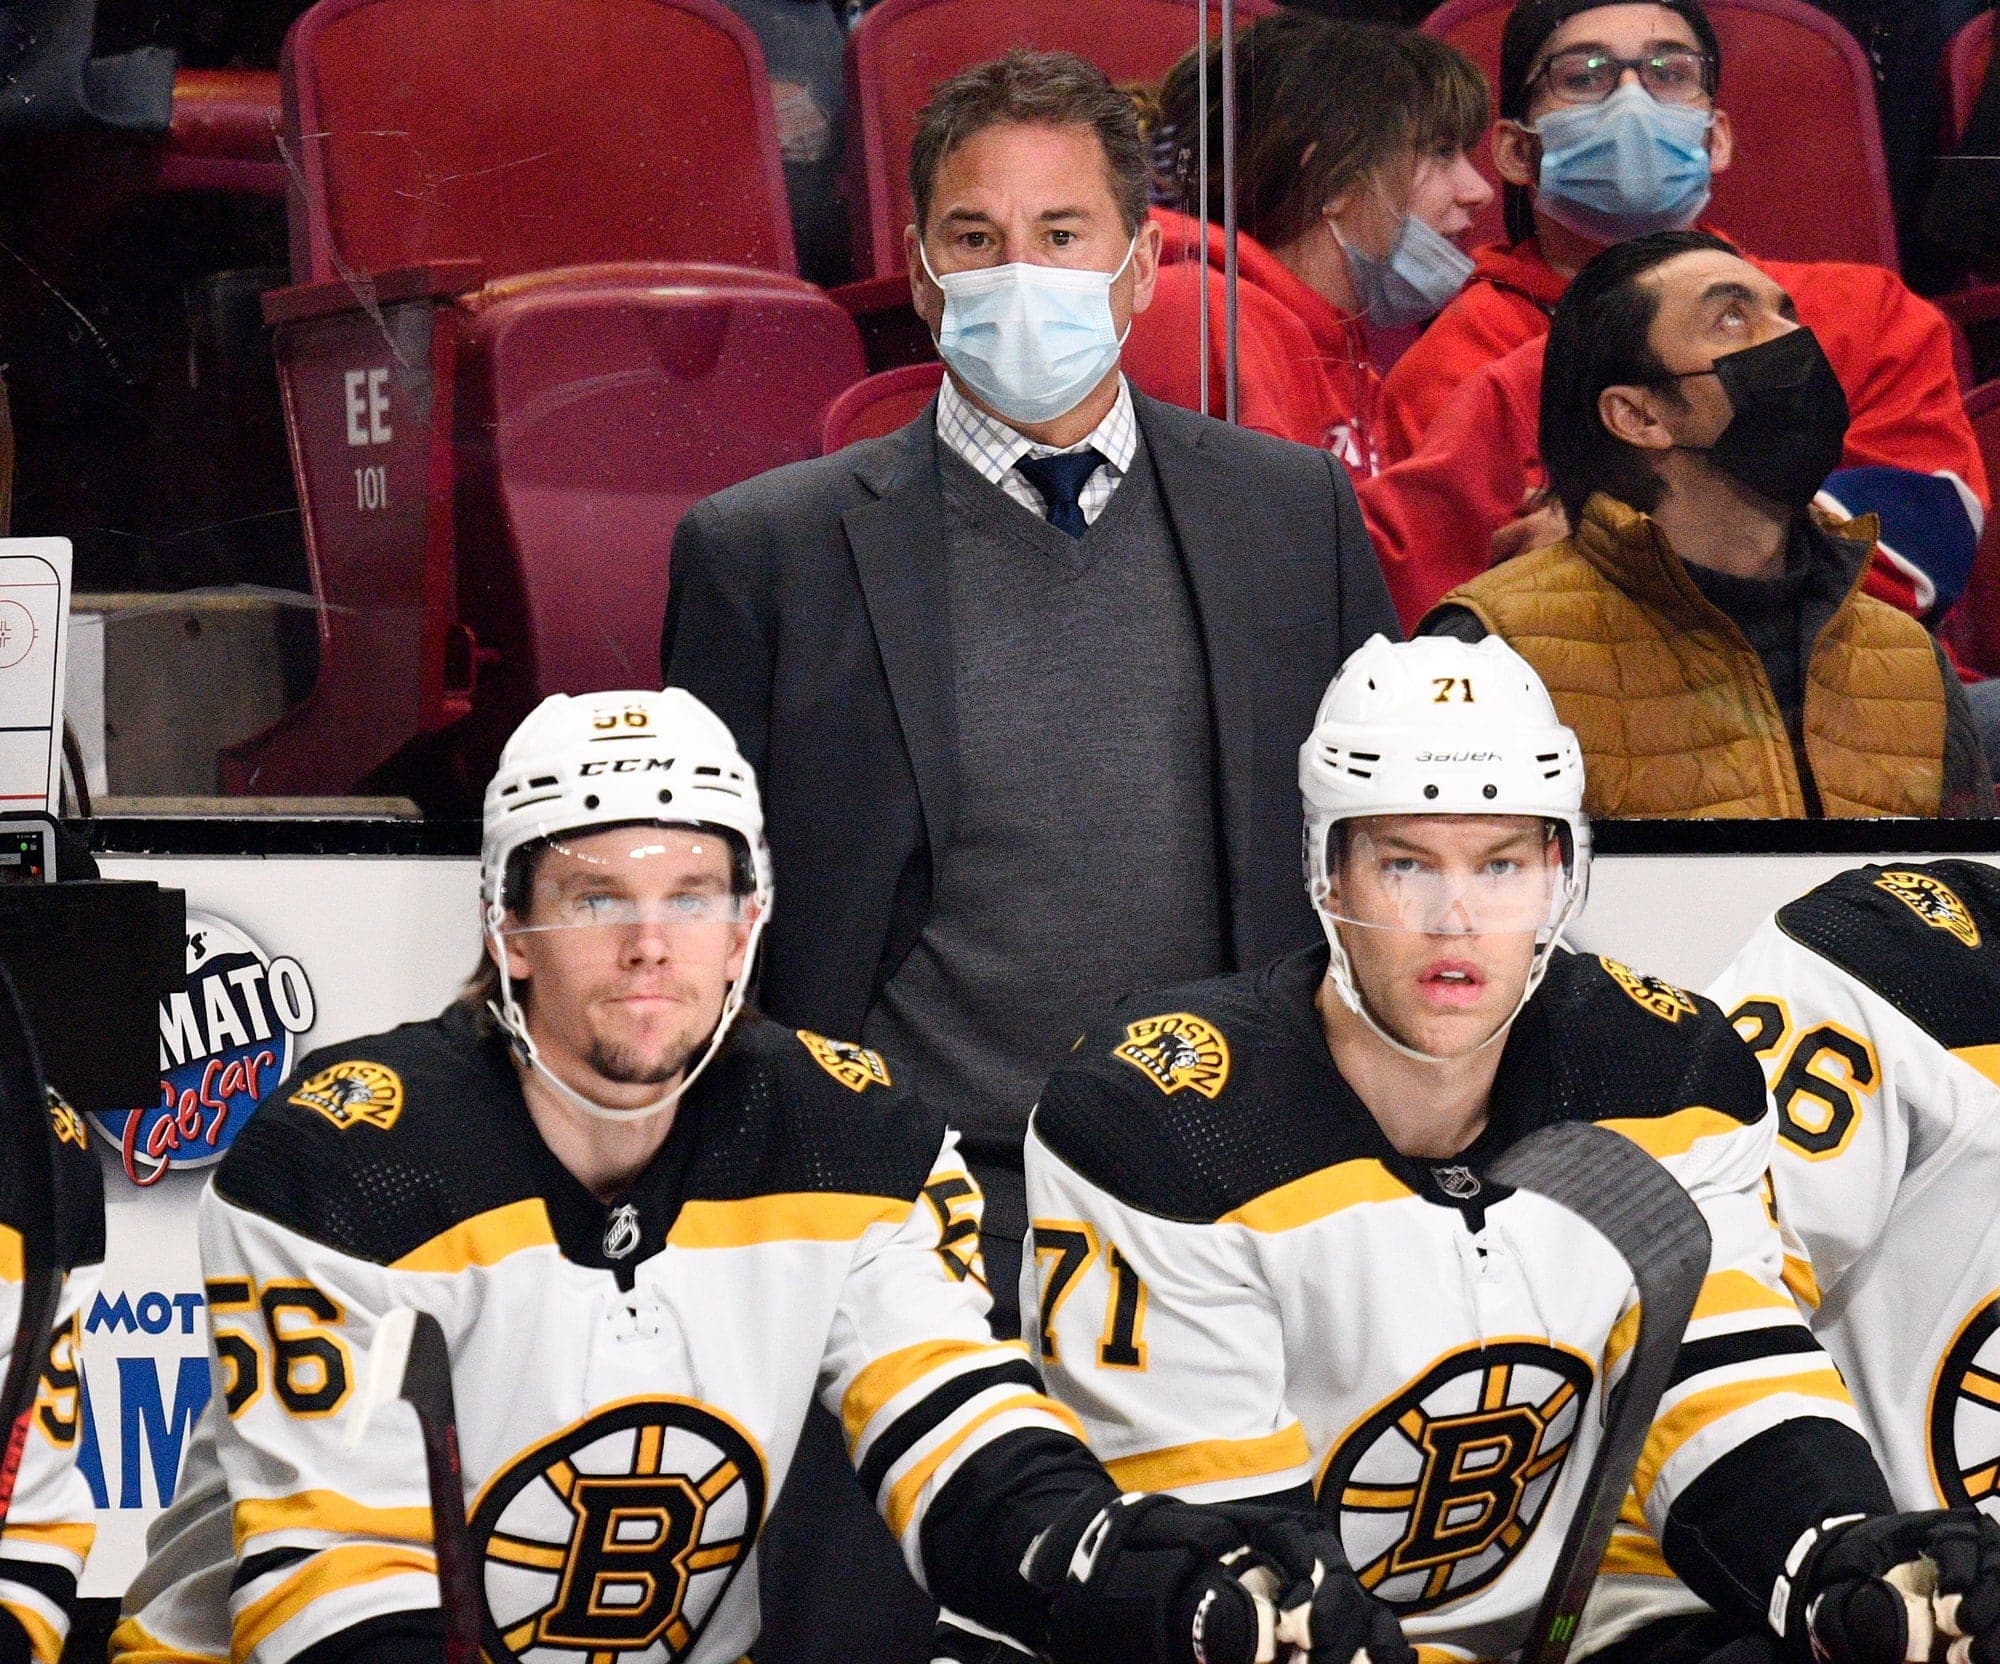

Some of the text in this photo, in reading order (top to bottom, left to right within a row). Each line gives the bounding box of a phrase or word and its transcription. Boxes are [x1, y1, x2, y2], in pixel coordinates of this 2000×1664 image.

[344, 367, 393, 446] EE
[354, 465, 387, 512] 101
[1431, 677, 1476, 704] 71
[578, 758, 676, 778] CCM
[1133, 1018, 1224, 1092] BOSTON
[84, 1289, 205, 1335] MOT
[1031, 1218, 1149, 1373] 71
[1389, 1401, 1545, 1575] B
[535, 1474, 706, 1650] B
